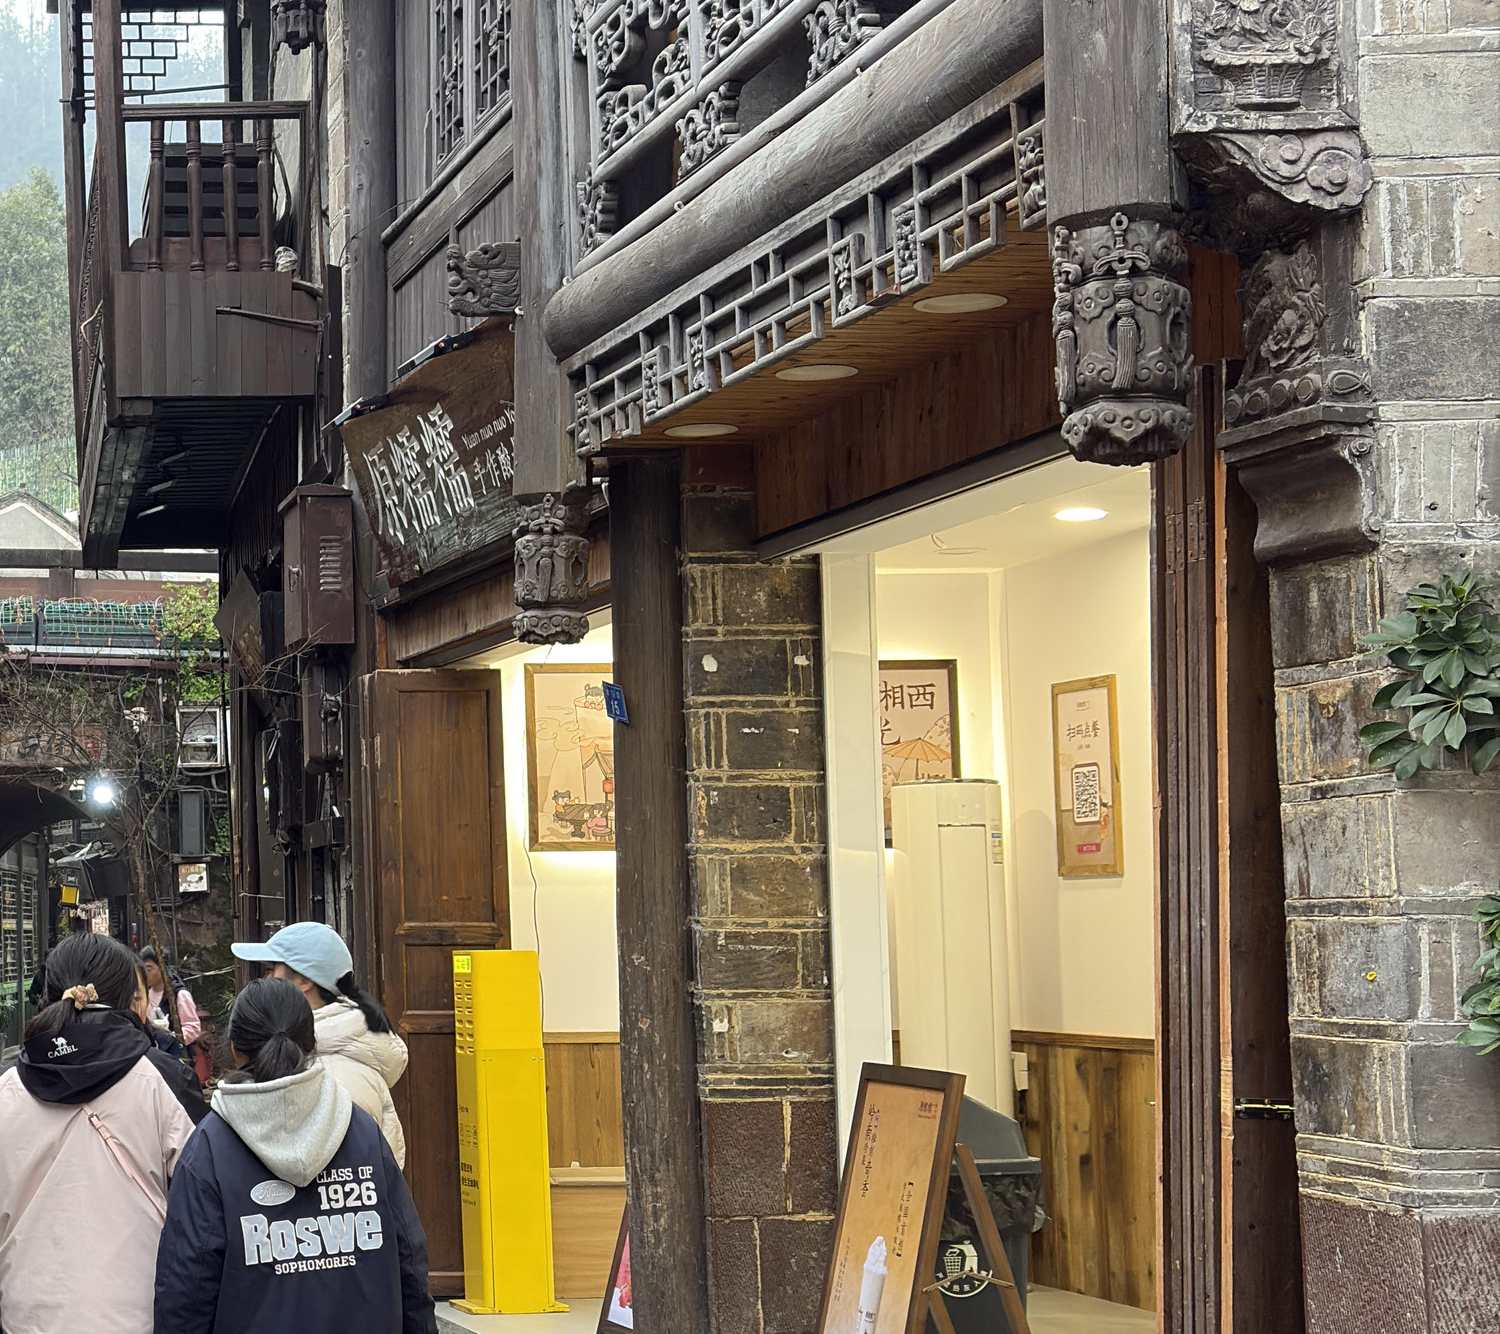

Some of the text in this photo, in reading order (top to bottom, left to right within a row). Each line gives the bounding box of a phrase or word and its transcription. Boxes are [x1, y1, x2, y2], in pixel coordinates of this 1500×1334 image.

[461, 432, 481, 451] Yuan
[480, 423, 493, 441] nuo
[493, 416, 507, 433] nuo
[473, 437, 515, 495] 手作酸
[48, 1046, 78, 1059] CAMEL
[316, 1166, 373, 1183] CLASS OF
[318, 1181, 378, 1210] 1926
[274, 1255, 357, 1275] SOPHOMORES
